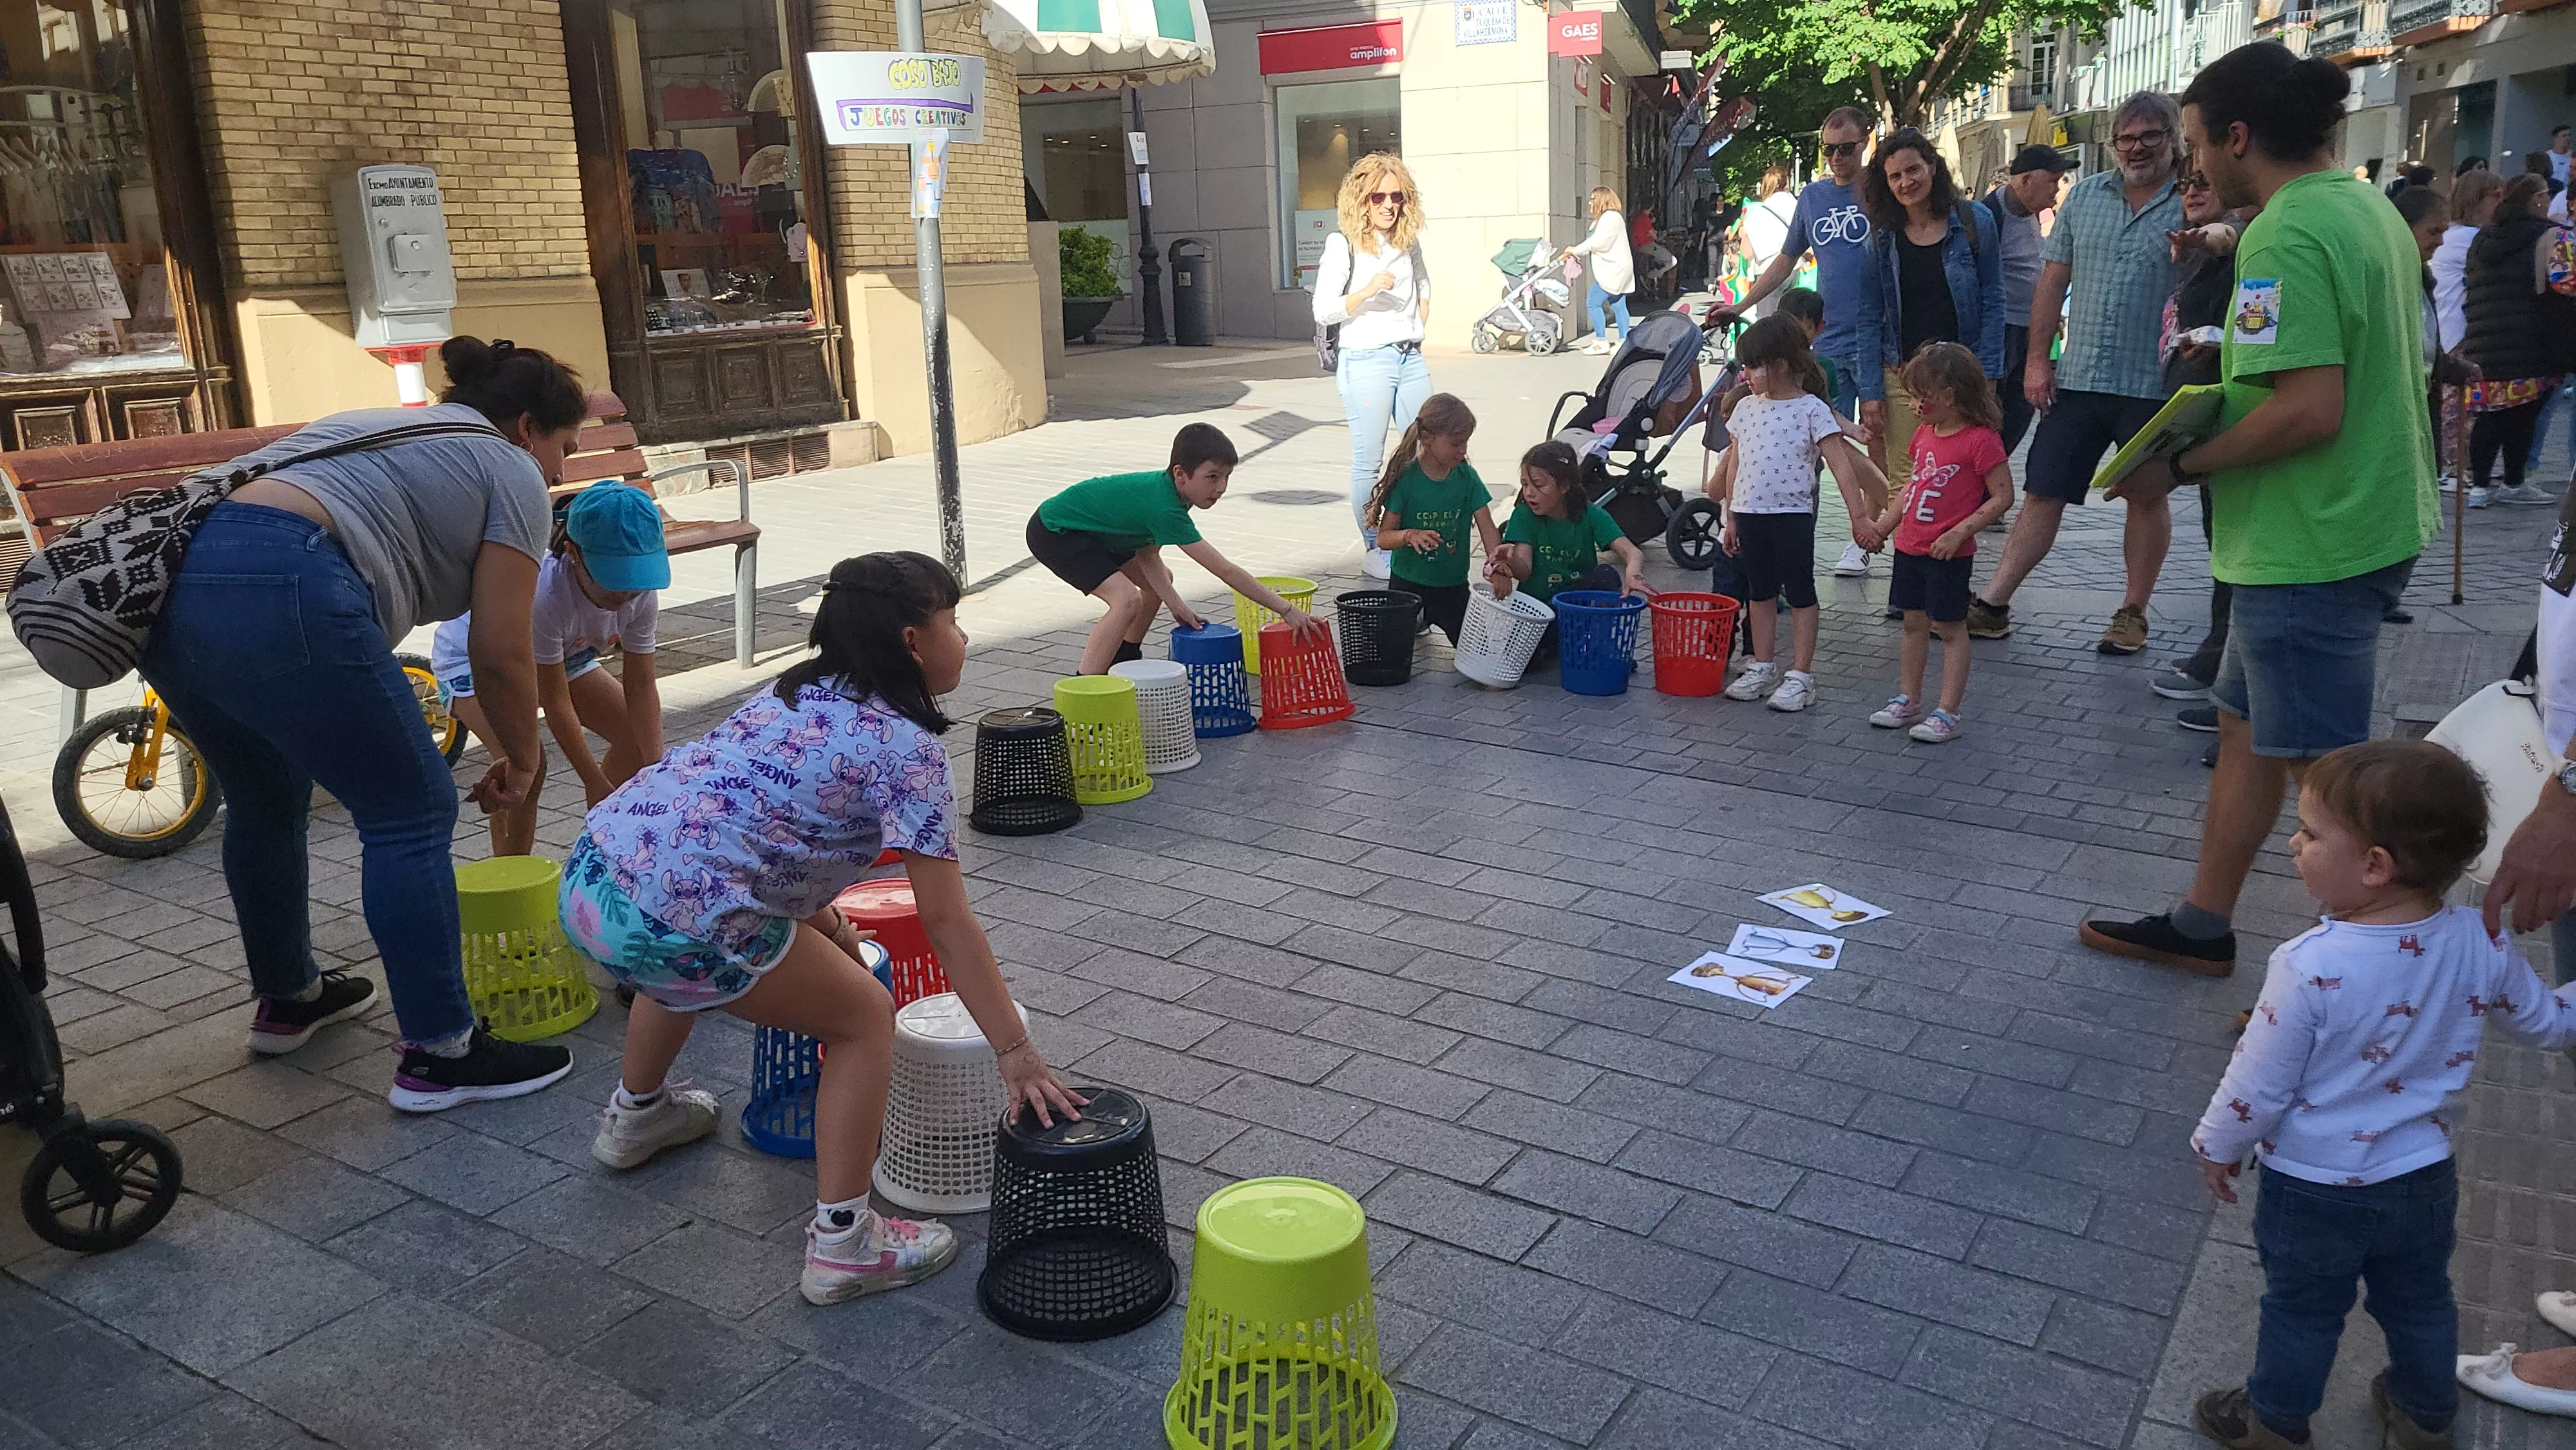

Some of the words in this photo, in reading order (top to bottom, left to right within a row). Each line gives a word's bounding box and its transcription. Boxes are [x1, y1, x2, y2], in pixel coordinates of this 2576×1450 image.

[1479, 6, 1508, 15] CALLE
[1476, 17, 1501, 26] DUQUESA
[1502, 15, 1510, 24] DE
[1463, 26, 1508, 37] VILLAHERMOSA
[1562, 23, 1598, 38] GAES
[1350, 47, 1397, 61] amplifon
[888, 58, 928, 89] COSO
[930, 58, 961, 87] BAJO
[850, 108, 906, 126] JUEGOS
[915, 109, 967, 126] CREATIVOS
[388, 177, 433, 189] AYUNTAMIENTO
[372, 195, 405, 207] ALUMBRADO
[747, 758, 802, 789] ANGEL
[627, 800, 670, 818] ANGEL
